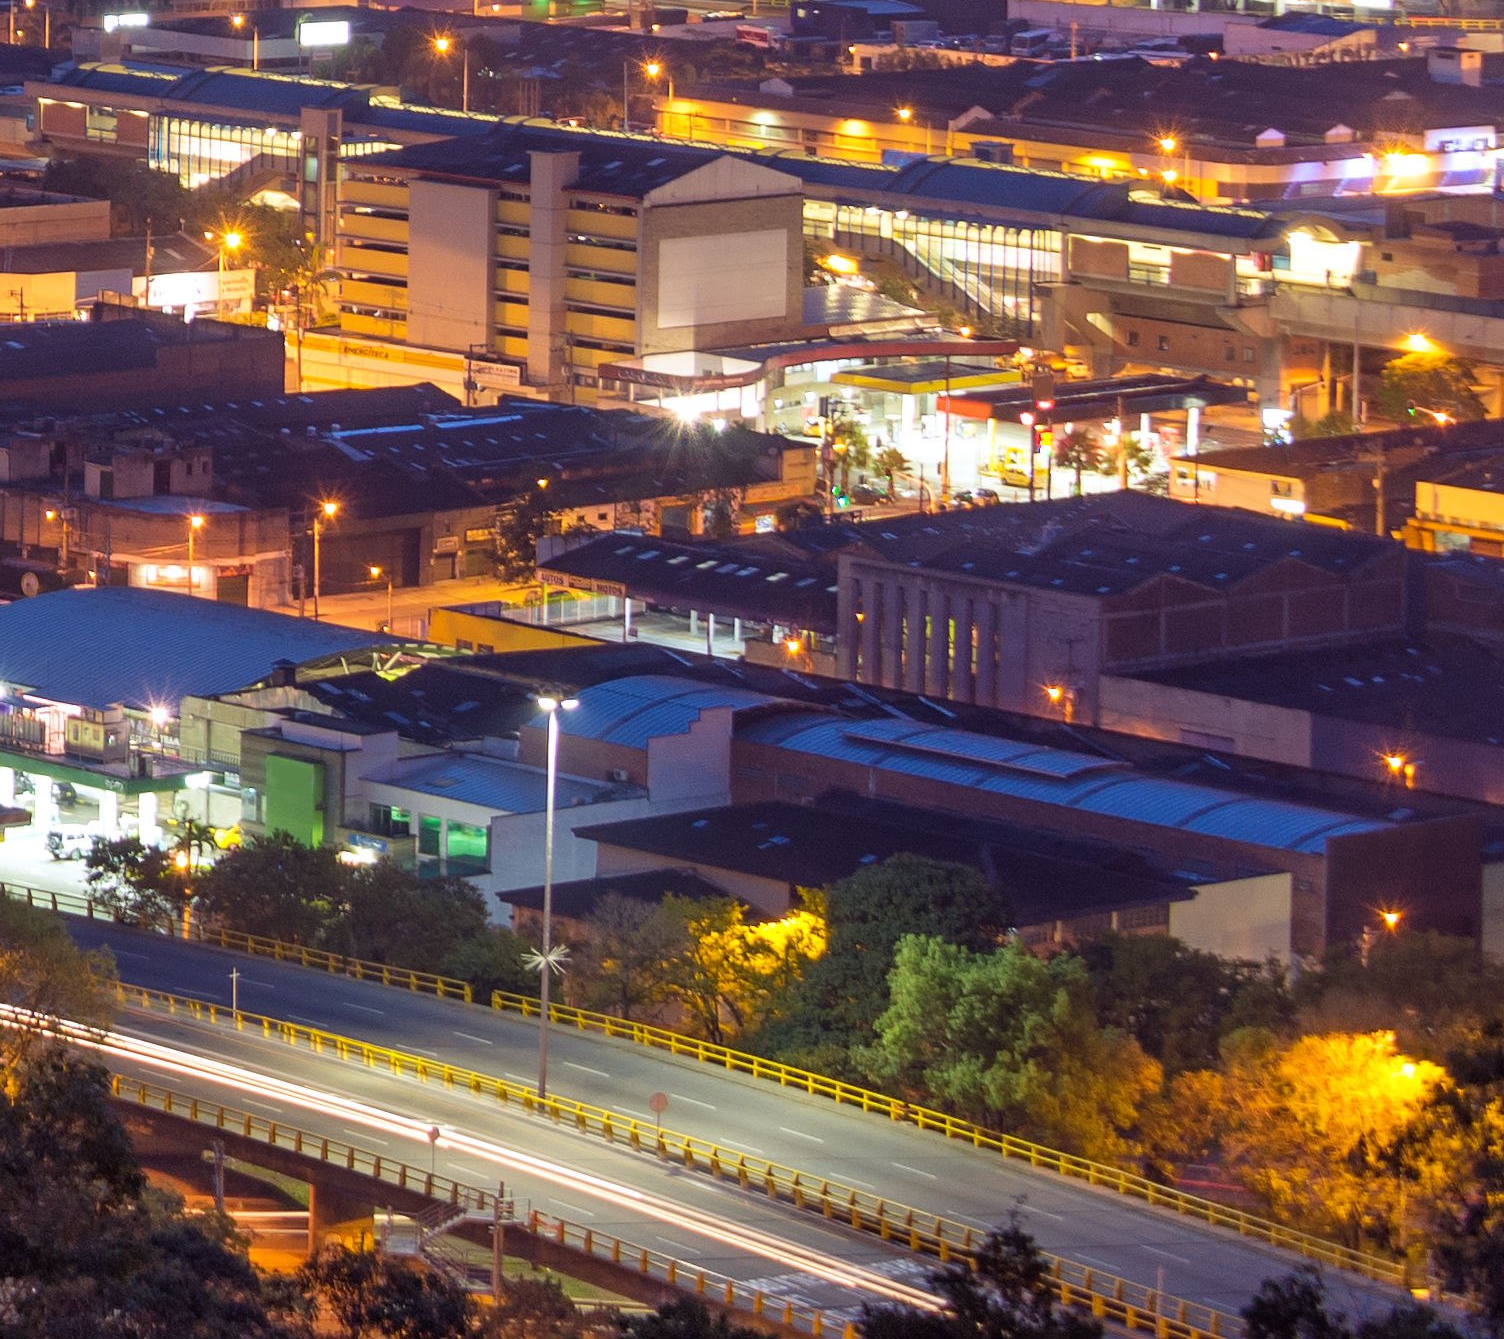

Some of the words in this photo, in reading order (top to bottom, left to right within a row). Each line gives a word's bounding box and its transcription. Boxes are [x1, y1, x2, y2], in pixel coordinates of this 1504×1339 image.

[344, 346, 389, 360] ENERGITECA
[541, 573, 564, 585] AUTOS
[596, 583, 623, 595] MOTOS
